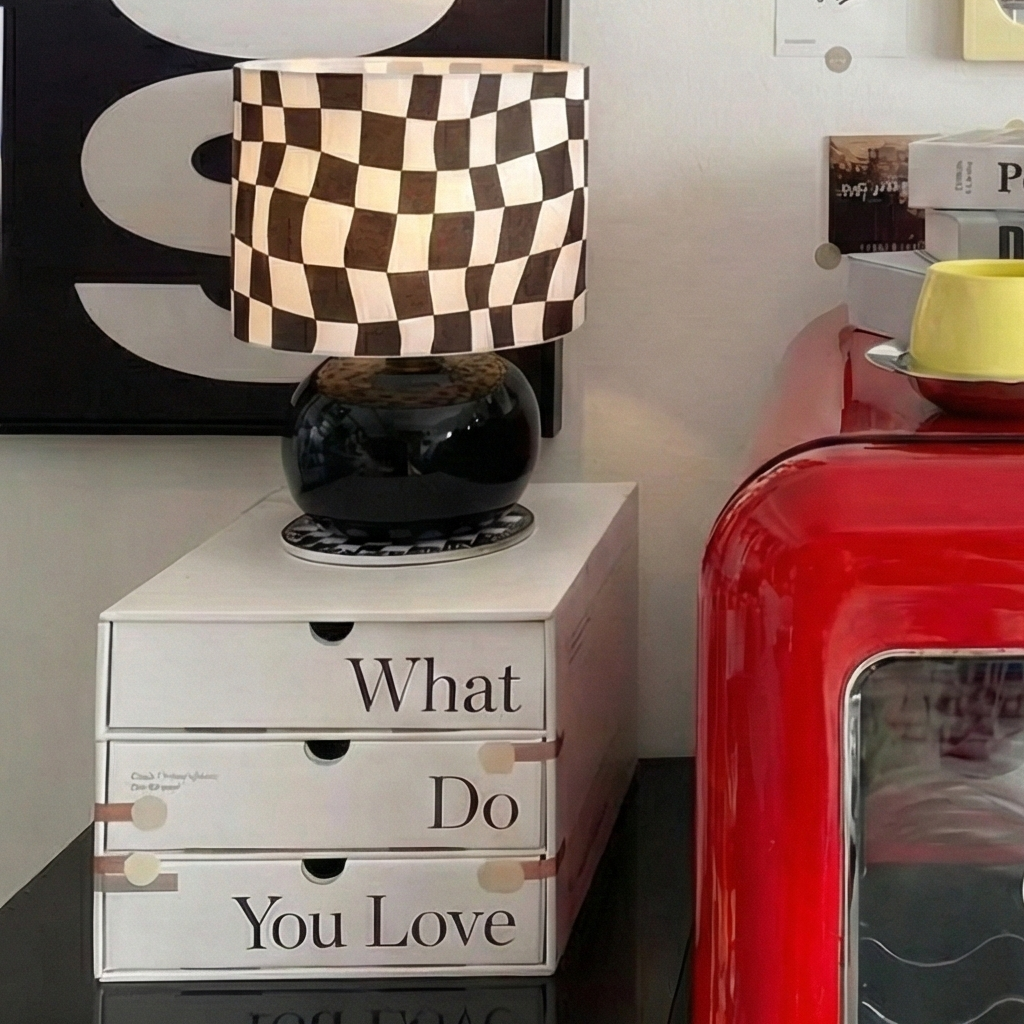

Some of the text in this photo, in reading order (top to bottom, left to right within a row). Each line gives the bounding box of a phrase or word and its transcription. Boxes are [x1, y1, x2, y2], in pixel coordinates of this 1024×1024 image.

[345, 656, 522, 713] What
[427, 775, 519, 830] Do
[231, 894, 516, 950] You Love
